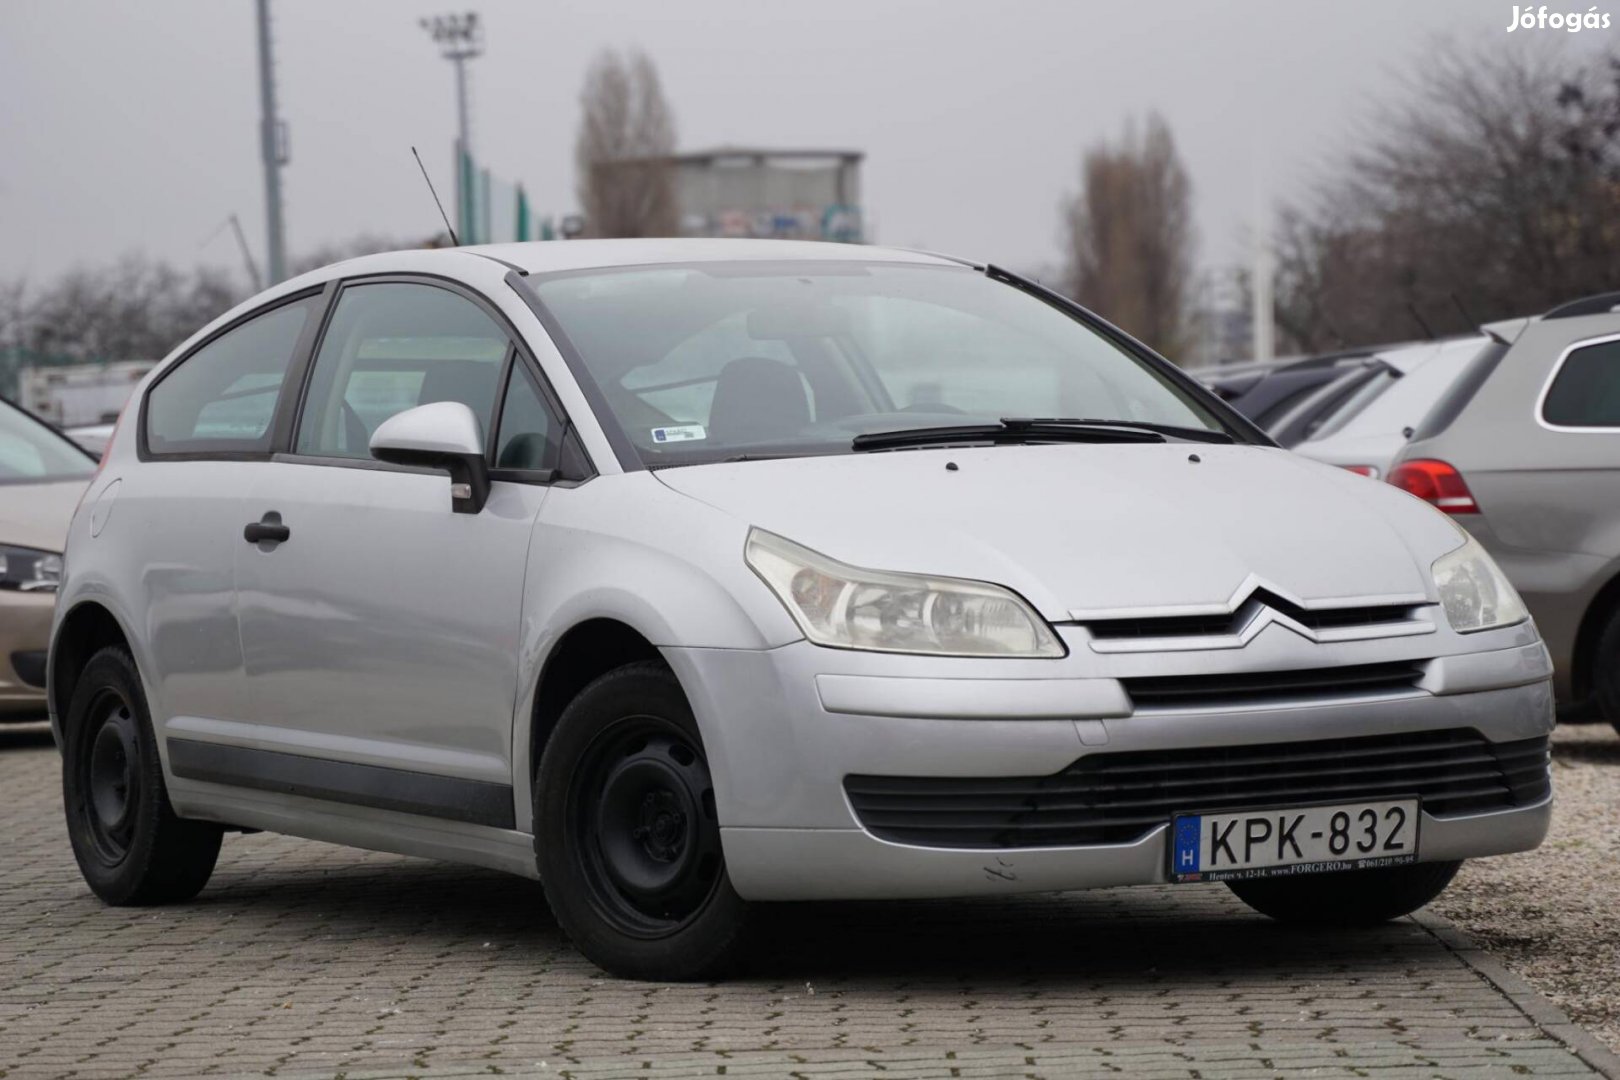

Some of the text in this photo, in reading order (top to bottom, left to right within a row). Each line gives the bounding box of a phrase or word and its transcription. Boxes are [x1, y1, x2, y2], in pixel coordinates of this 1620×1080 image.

[1210, 806, 1406, 866] KPK-832
[1182, 849, 1194, 867] H
[1271, 861, 1352, 875] www.FORGERO.hu
